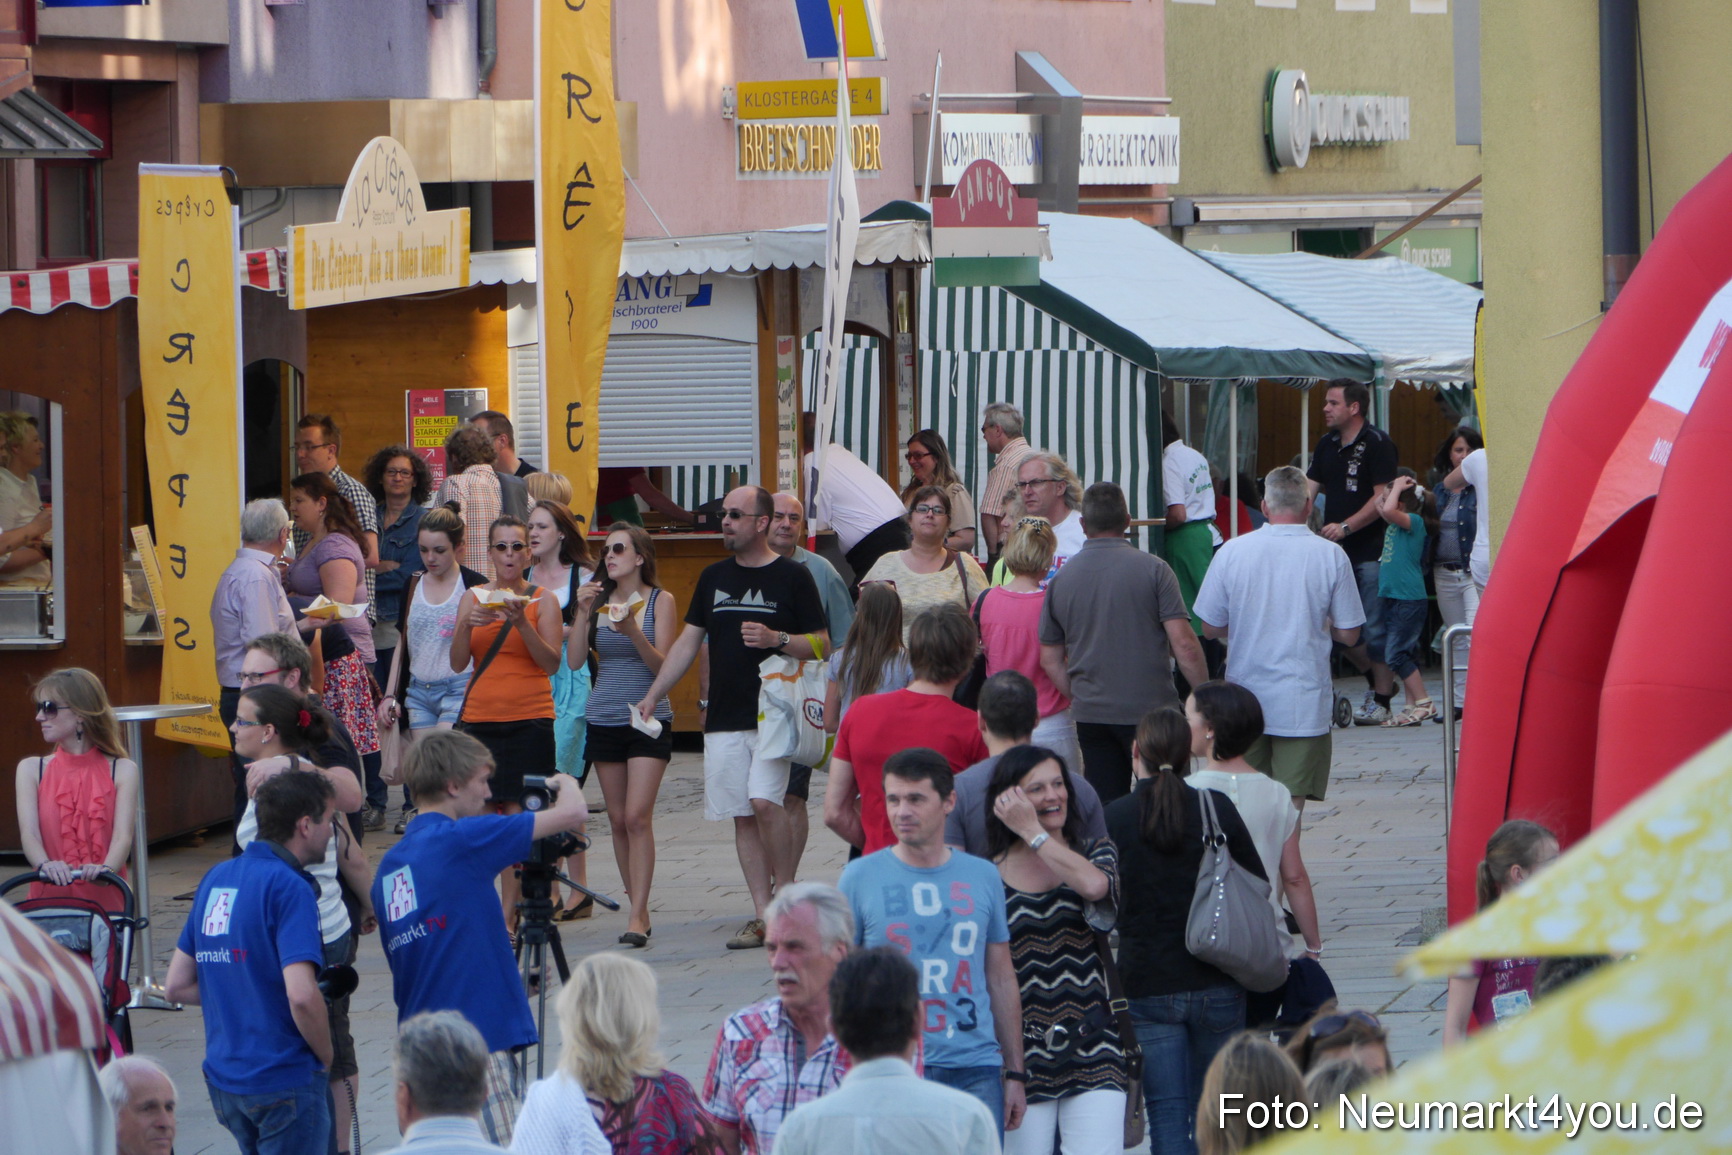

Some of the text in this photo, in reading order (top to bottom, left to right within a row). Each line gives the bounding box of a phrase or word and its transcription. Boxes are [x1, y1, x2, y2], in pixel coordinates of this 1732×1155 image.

[744, 89, 873, 108] KLOSTERGASE 4
[1363, 95, 1410, 142] SCHUH
[741, 123, 883, 172] BRETSCHNDER
[942, 131, 1043, 167] KOMMUNIKATION
[1079, 126, 1178, 167] ÜROELEKTRONIK
[374, 143, 414, 226] Crêpe
[957, 166, 1013, 223] LANGOS
[312, 239, 325, 291] Die
[369, 236, 381, 285] die
[384, 248, 394, 281] zu
[397, 231, 418, 280] Ihnen
[421, 231, 446, 278] kommt
[615, 275, 673, 302] ANG
[613, 302, 683, 317] ischbraterei
[631, 318, 659, 330] 1900
[415, 428, 443, 436] STARKE
[433, 417, 456, 425] MEILE
[415, 438, 438, 446] TOLLE
[388, 914, 446, 953] umarkt TV
[196, 947, 247, 963] emarkt TV
